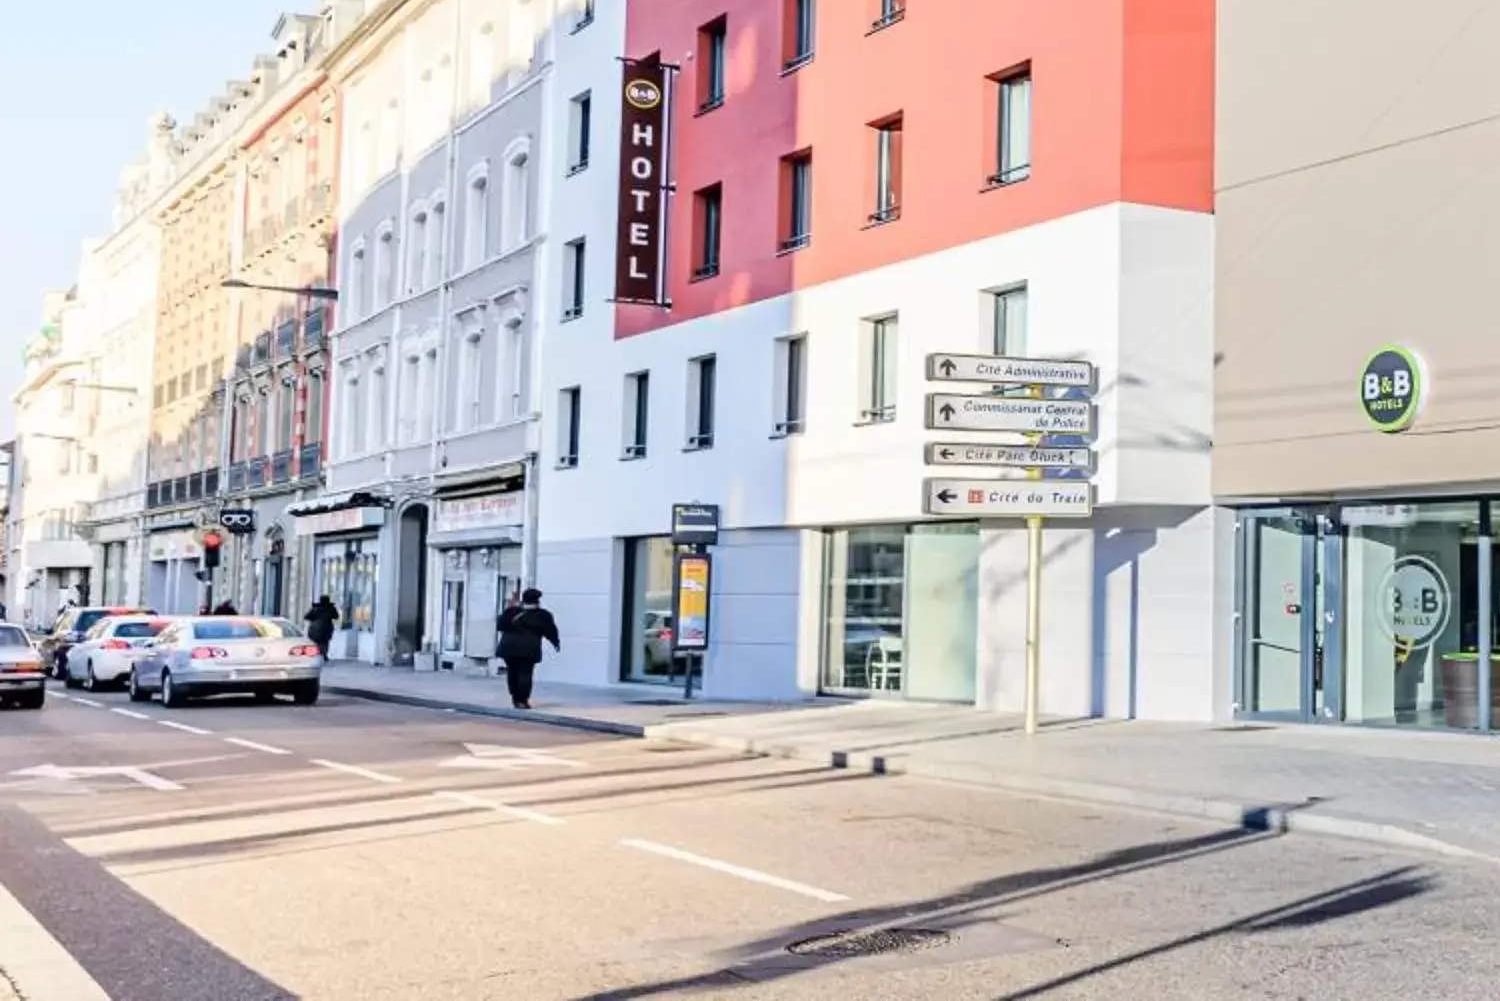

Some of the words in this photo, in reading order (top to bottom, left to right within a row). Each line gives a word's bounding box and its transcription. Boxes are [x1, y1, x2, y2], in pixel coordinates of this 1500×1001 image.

[629, 123, 653, 279] HOTEL
[976, 363, 1000, 376] Cité
[1004, 364, 1086, 380] Administrative
[1364, 370, 1411, 400] B&B
[963, 400, 1042, 415] Commissariat
[1045, 404, 1086, 416] Central
[1369, 398, 1404, 411] HOTELS
[1051, 417, 1086, 429] Police
[989, 491, 1019, 503] Cité
[1051, 492, 1086, 504] Train
